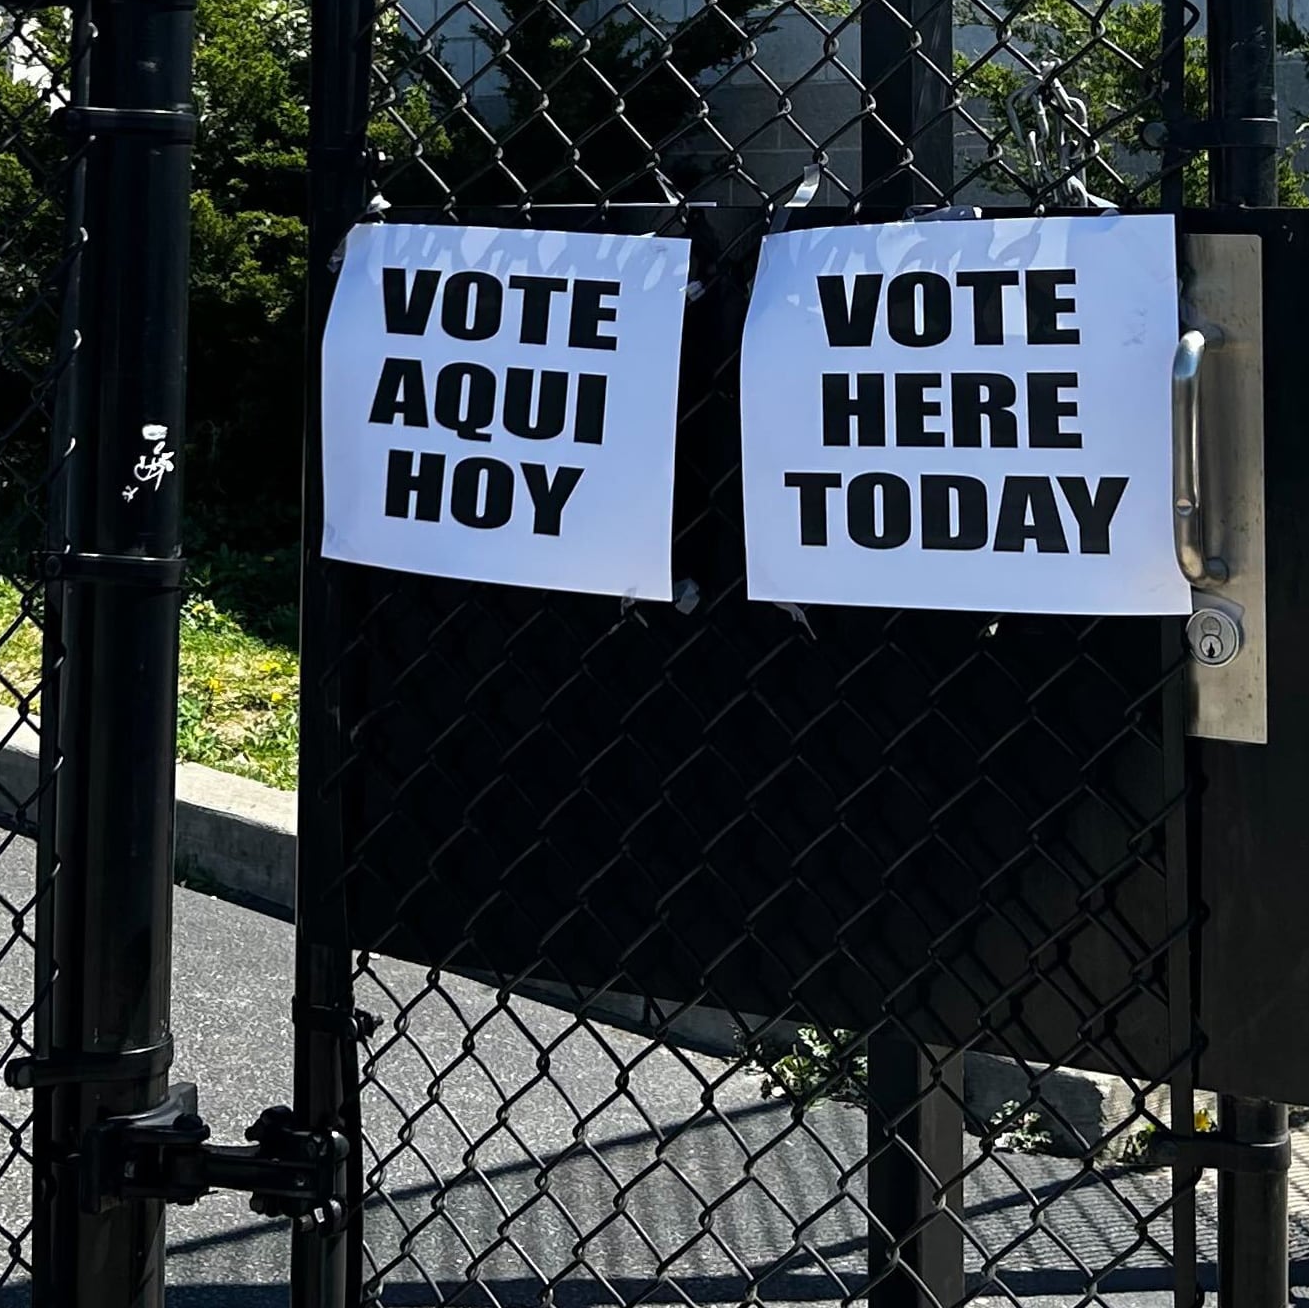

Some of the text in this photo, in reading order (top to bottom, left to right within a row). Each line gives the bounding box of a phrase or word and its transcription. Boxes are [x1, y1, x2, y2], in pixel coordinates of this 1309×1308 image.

[382, 267, 621, 351] VOTE
[817, 268, 1081, 348] VOTE
[368, 357, 608, 446] AQUI
[822, 372, 1083, 449] HERE
[385, 449, 584, 537] HOY
[784, 472, 1130, 555] TODAY
